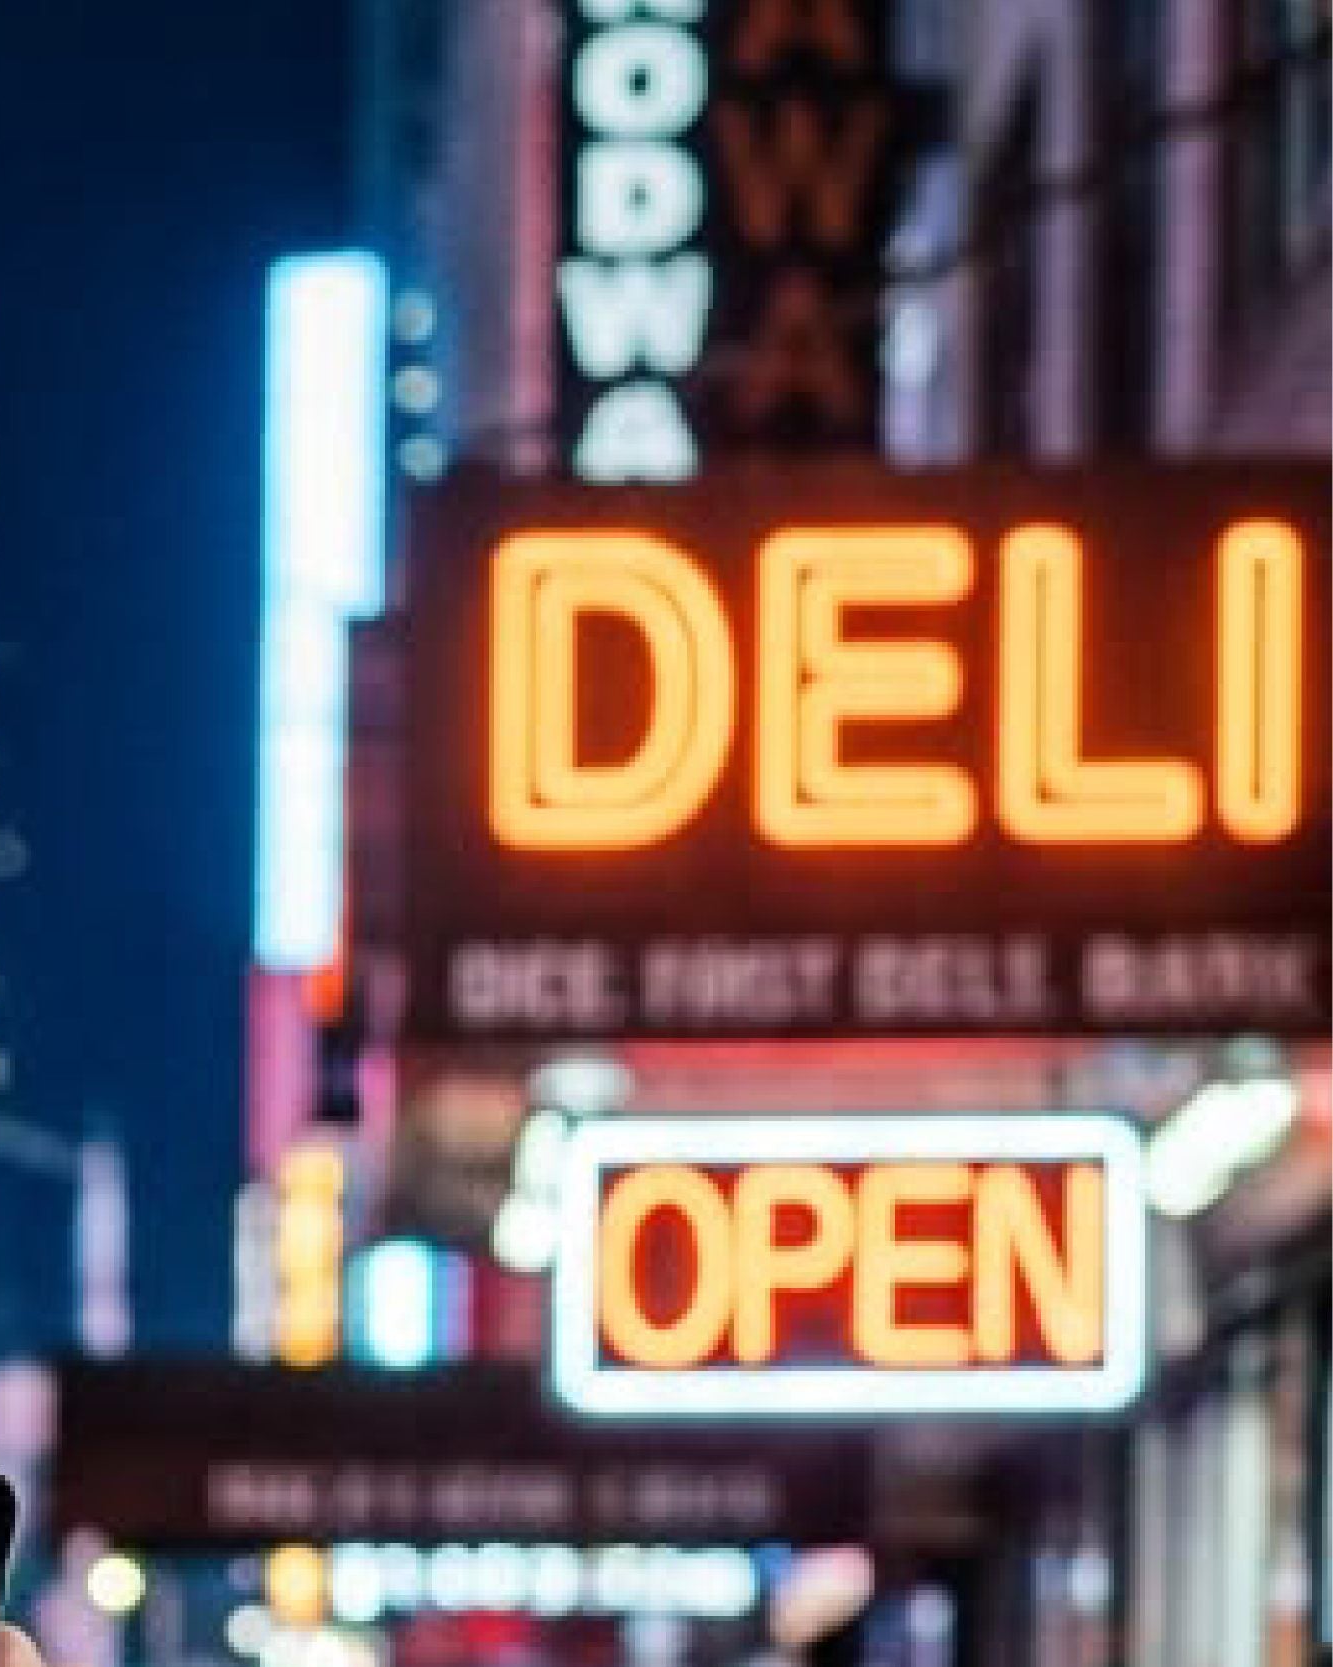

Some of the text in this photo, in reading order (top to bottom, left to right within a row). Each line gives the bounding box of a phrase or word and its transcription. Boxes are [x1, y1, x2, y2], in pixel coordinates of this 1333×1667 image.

[557, 0, 713, 486] ODWA
[489, 520, 1305, 850] DELI
[597, 1160, 1107, 1370] OPEN
